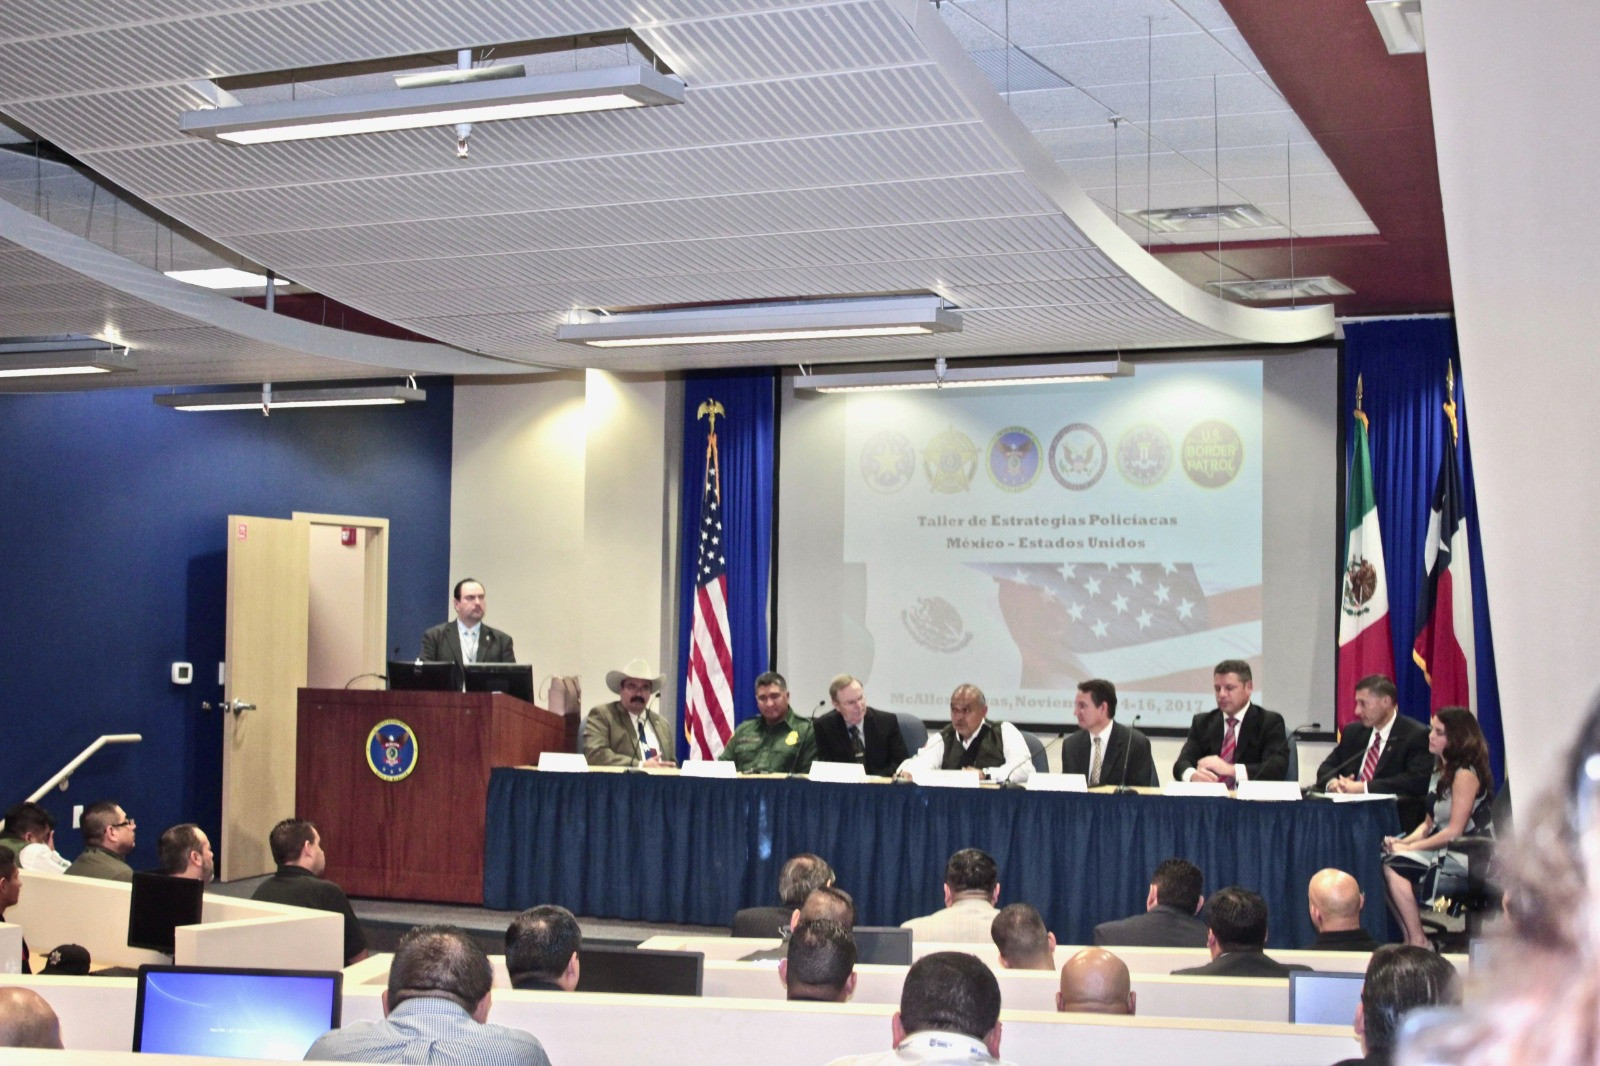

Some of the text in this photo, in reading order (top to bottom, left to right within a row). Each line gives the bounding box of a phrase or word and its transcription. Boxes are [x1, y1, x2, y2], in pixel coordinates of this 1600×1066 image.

[1186, 444, 1237, 457] BORDER
[1187, 459, 1234, 472] PATROL
[917, 515, 964, 527] Taller
[968, 515, 987, 527] de
[991, 514, 1086, 529] Estrategias
[946, 537, 1005, 549] México
[1018, 537, 1085, 549] Estados
[1087, 537, 1146, 549] Unidos
[1165, 699, 1203, 713] 2017
